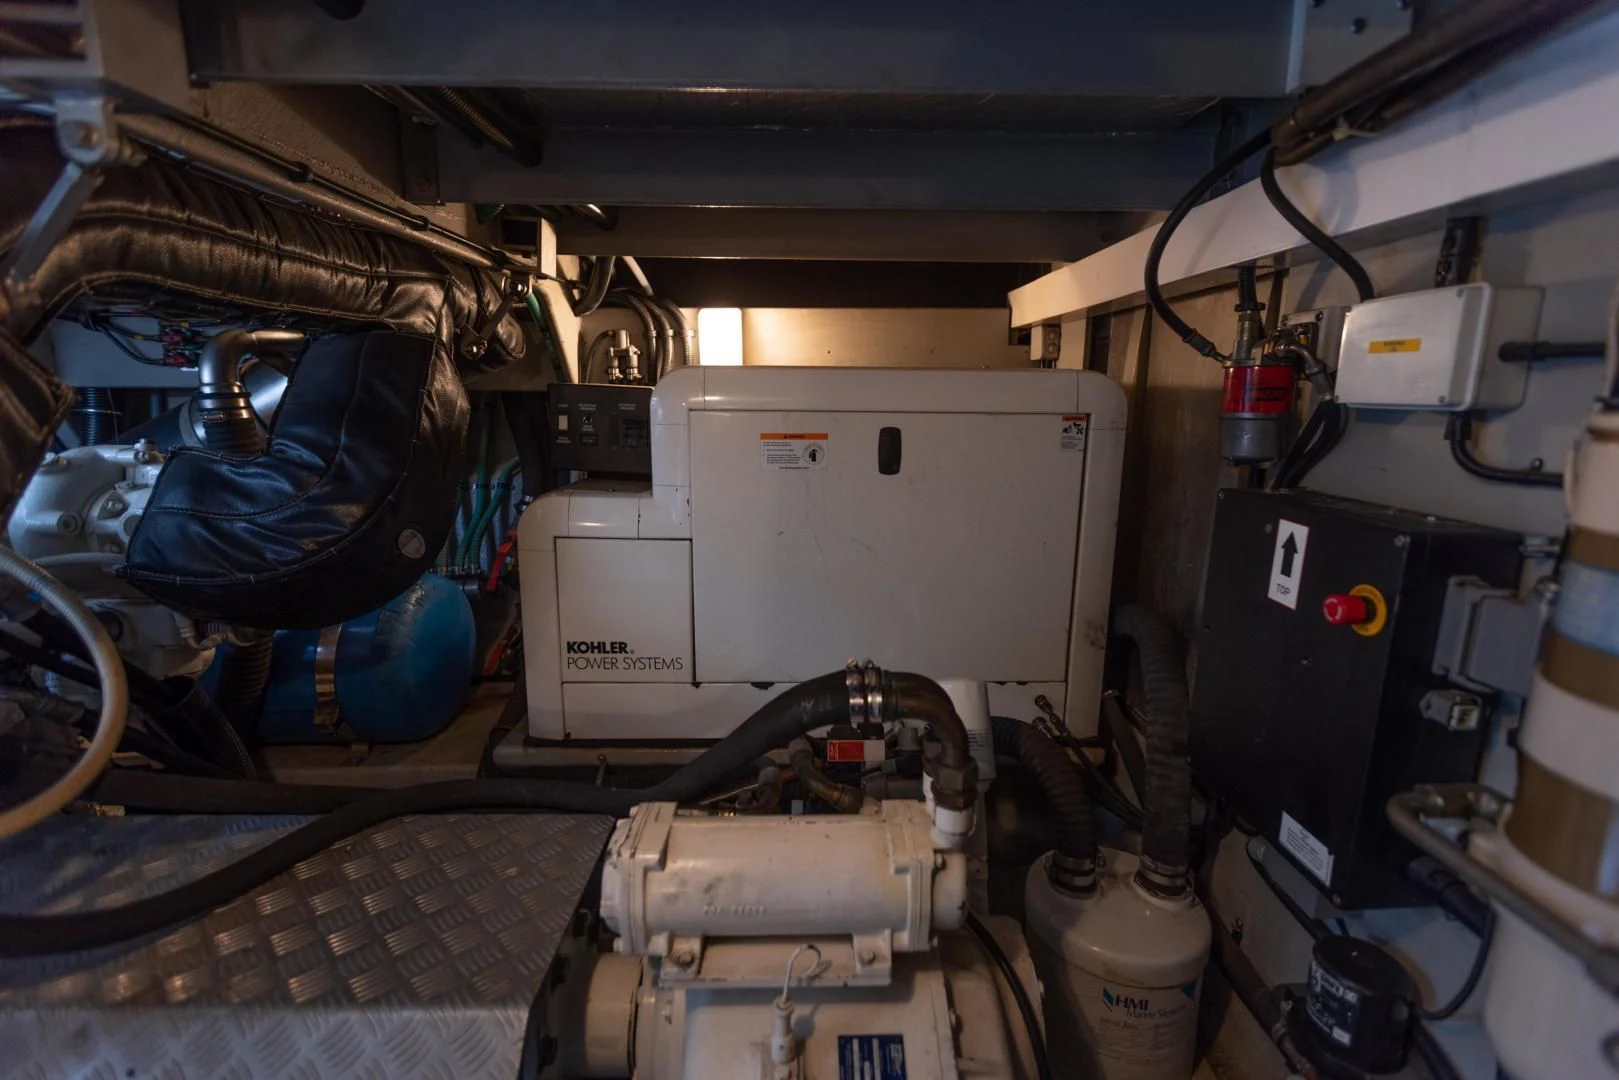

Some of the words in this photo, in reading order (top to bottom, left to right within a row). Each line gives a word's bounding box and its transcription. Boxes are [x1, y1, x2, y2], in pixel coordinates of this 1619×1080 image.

[1276, 583, 1291, 596] TOP
[567, 656, 619, 670] POWER
[623, 656, 684, 670] SYSTEMS
[1115, 995, 1149, 1011] HMI
